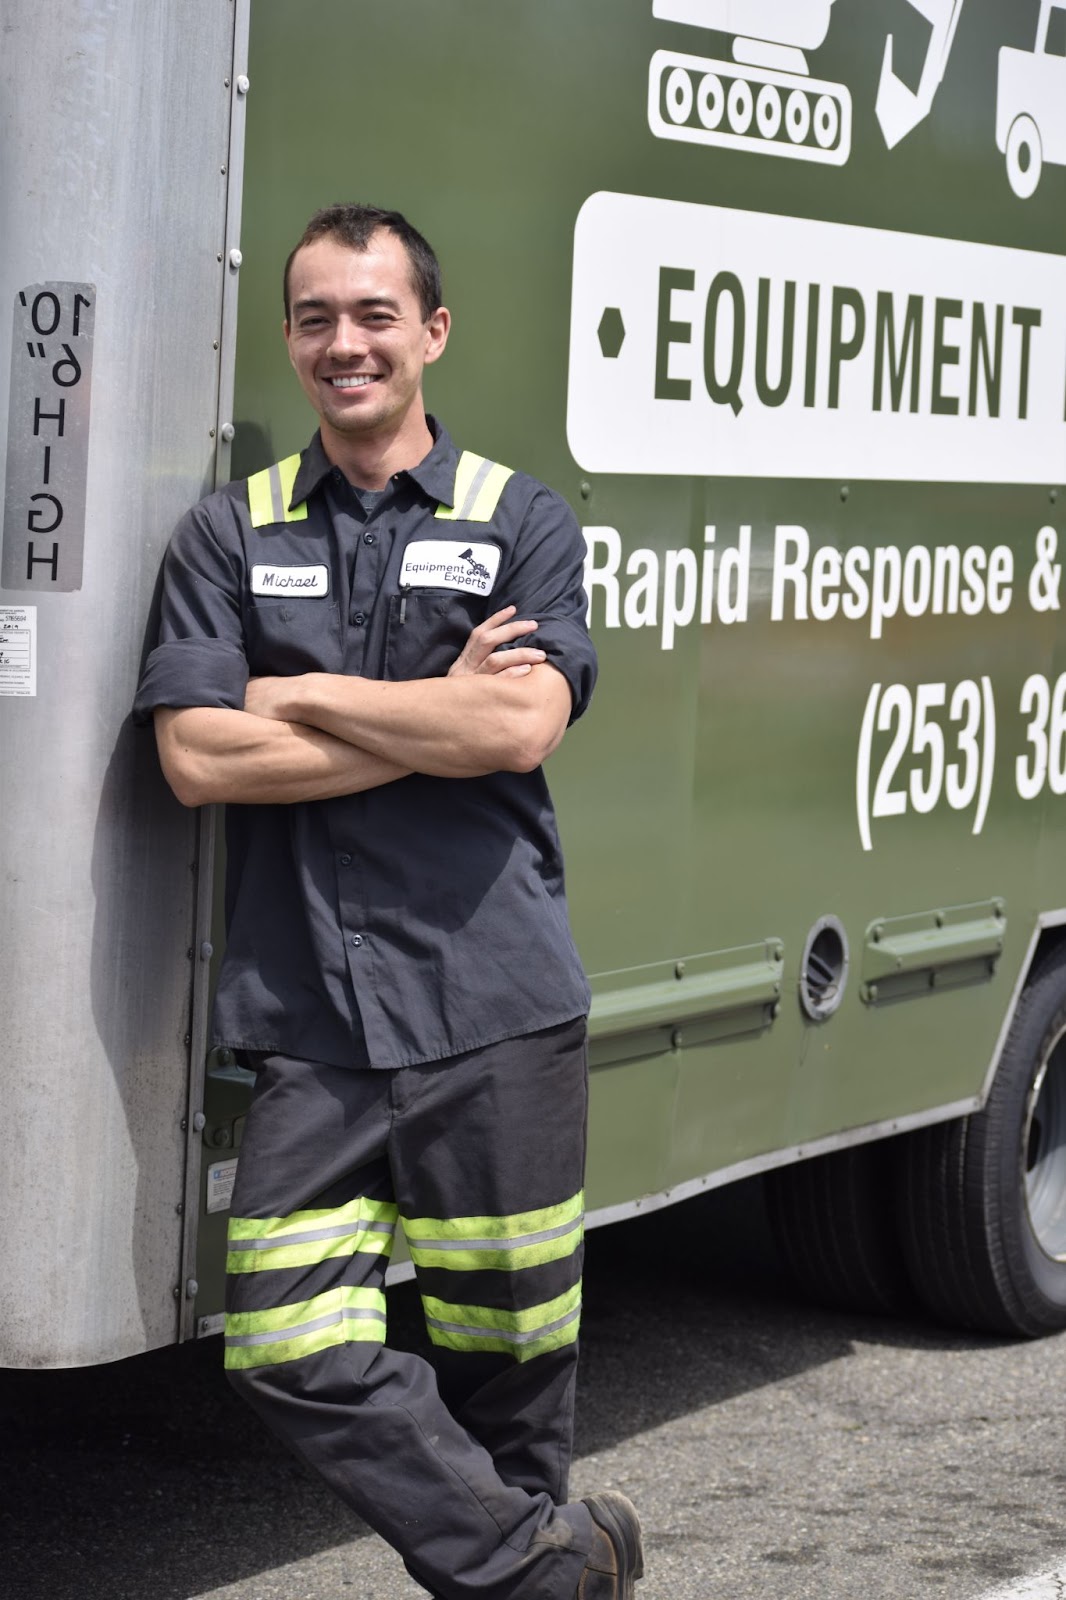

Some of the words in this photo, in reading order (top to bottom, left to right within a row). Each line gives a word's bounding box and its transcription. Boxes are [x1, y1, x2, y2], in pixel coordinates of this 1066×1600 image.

[654, 265, 1042, 420] EQUIPMENT
[262, 573, 318, 588] Michael
[405, 562, 465, 574] Equipment
[444, 571, 487, 590] Experts
[581, 525, 751, 650] Rapid
[770, 525, 1014, 639] Response
[1028, 525, 1062, 612] &
[856, 675, 996, 851] (253)
